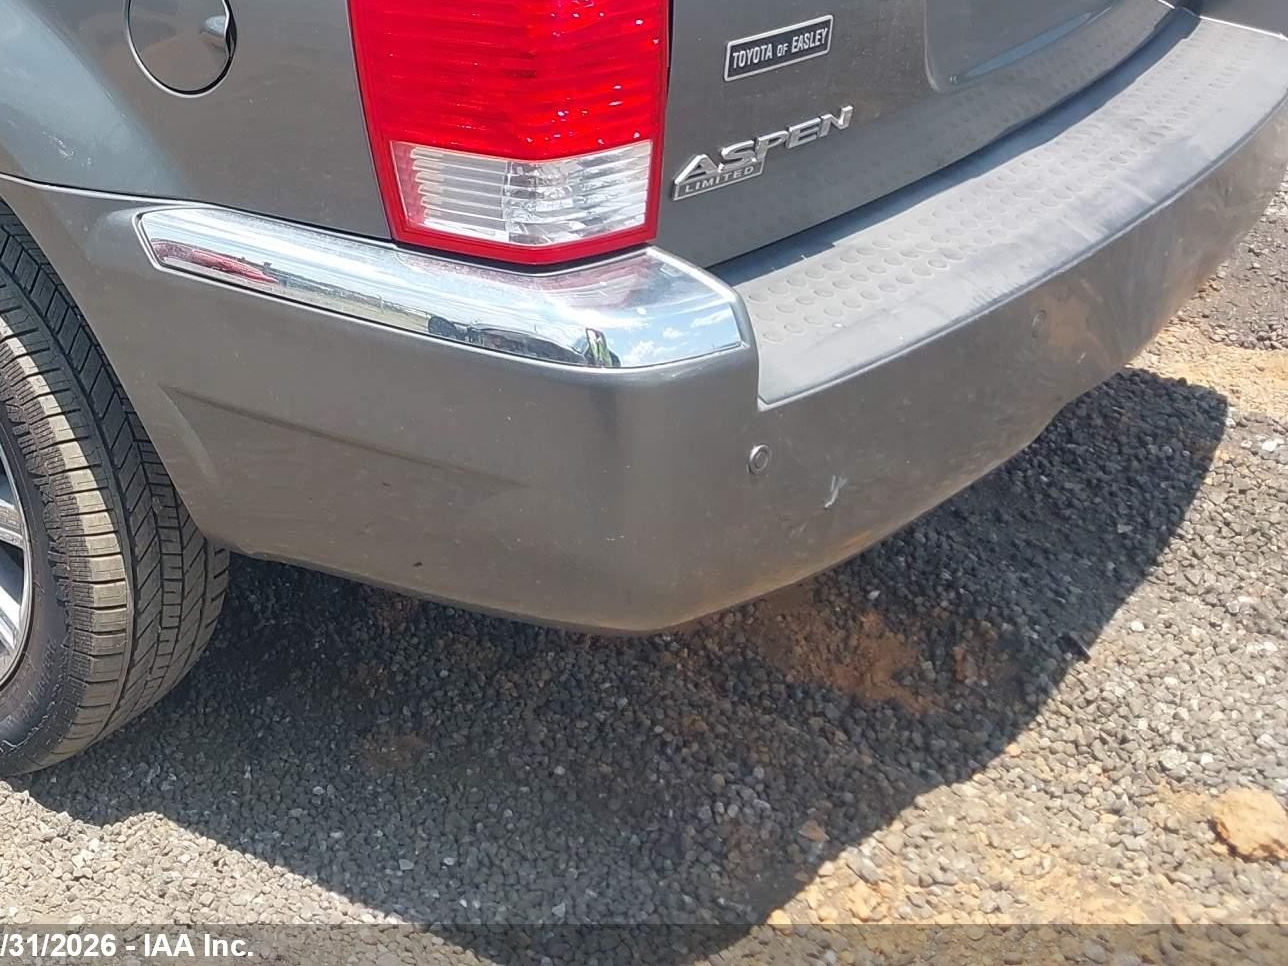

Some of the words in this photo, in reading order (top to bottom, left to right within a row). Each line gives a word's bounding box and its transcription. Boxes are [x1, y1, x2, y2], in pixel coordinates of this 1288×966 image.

[732, 44, 773, 69] TOYOTA
[776, 43, 789, 57] OF
[791, 27, 828, 54] EASLEY
[675, 105, 853, 185] ASPEN
[684, 165, 755, 193] LIMITED
